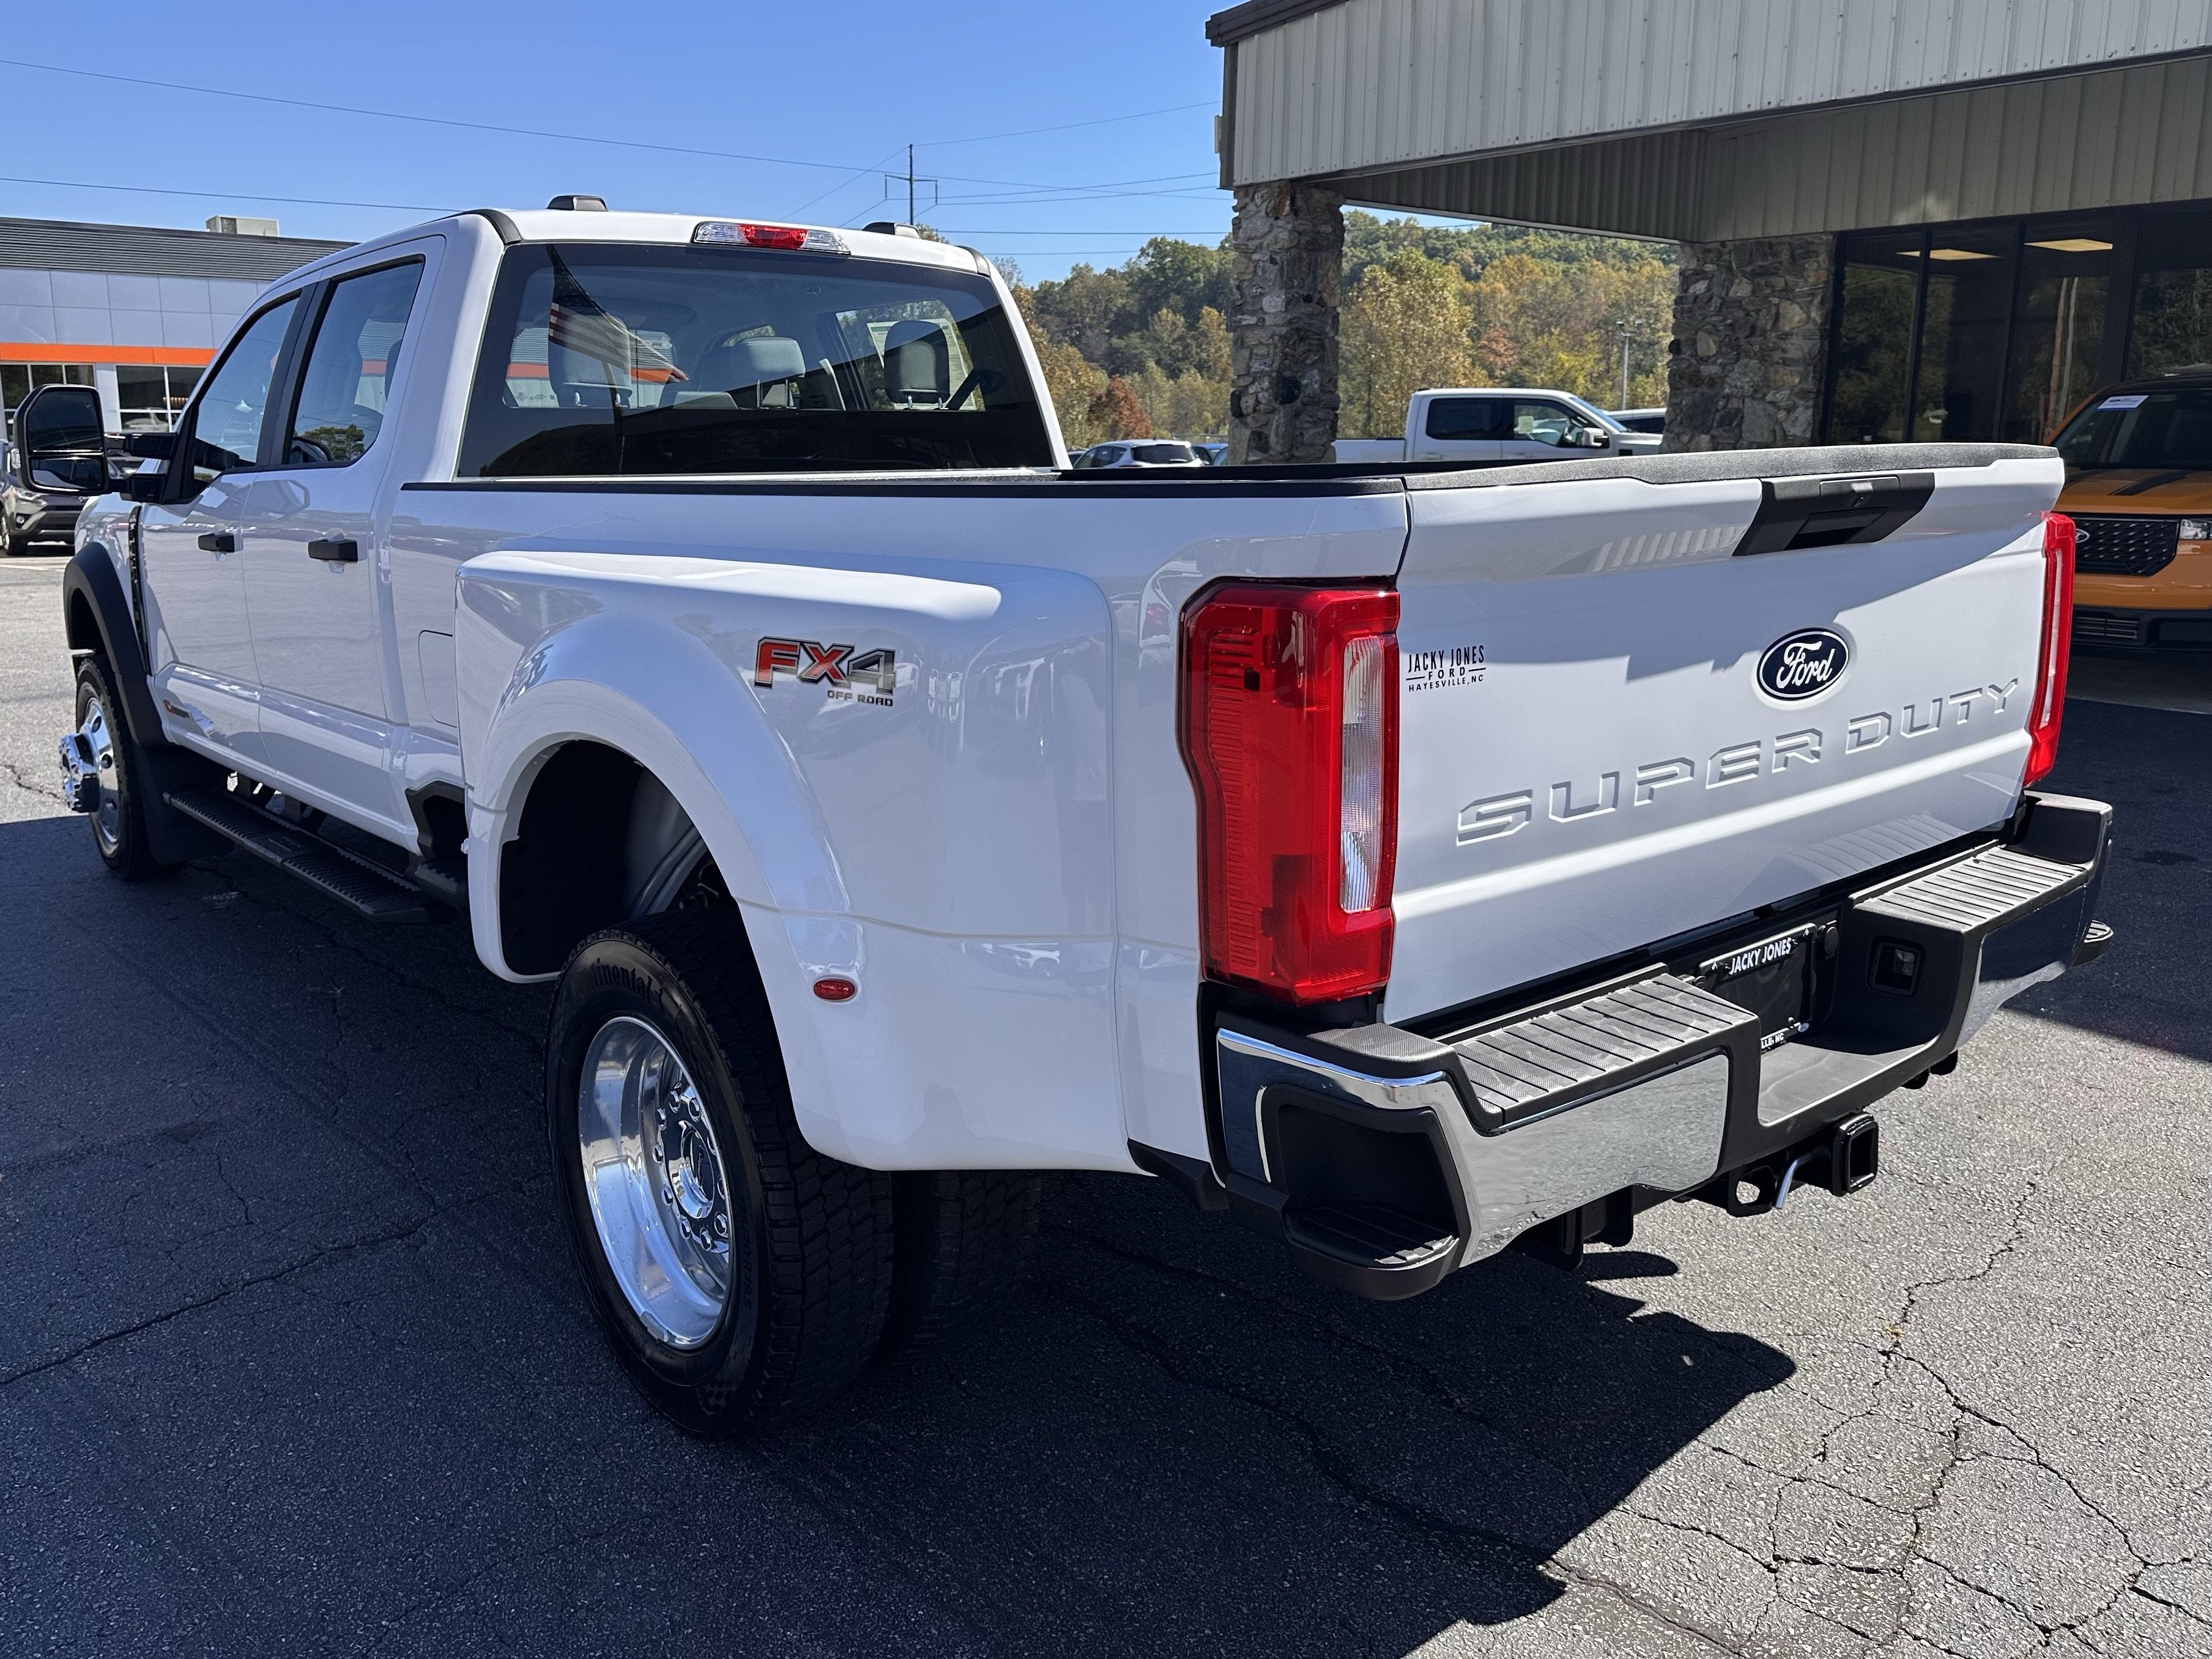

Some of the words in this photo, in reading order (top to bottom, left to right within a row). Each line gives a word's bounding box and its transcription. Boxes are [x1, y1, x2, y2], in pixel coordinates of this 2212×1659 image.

[754, 636, 896, 696] FX4
[1408, 650, 1444, 673] JACKY
[1450, 645, 1484, 667] JONES
[1428, 666, 1466, 680] FORD
[1776, 640, 1835, 689] Ford
[827, 689, 853, 700] OFF
[857, 694, 893, 707] ROAD
[1456, 727, 1823, 847] SUPER
[1845, 677, 2019, 754] DUTY
[1729, 948, 1761, 975] JACKY
[1762, 937, 1791, 963] JONES
[1775, 1033, 1784, 1043] NC
